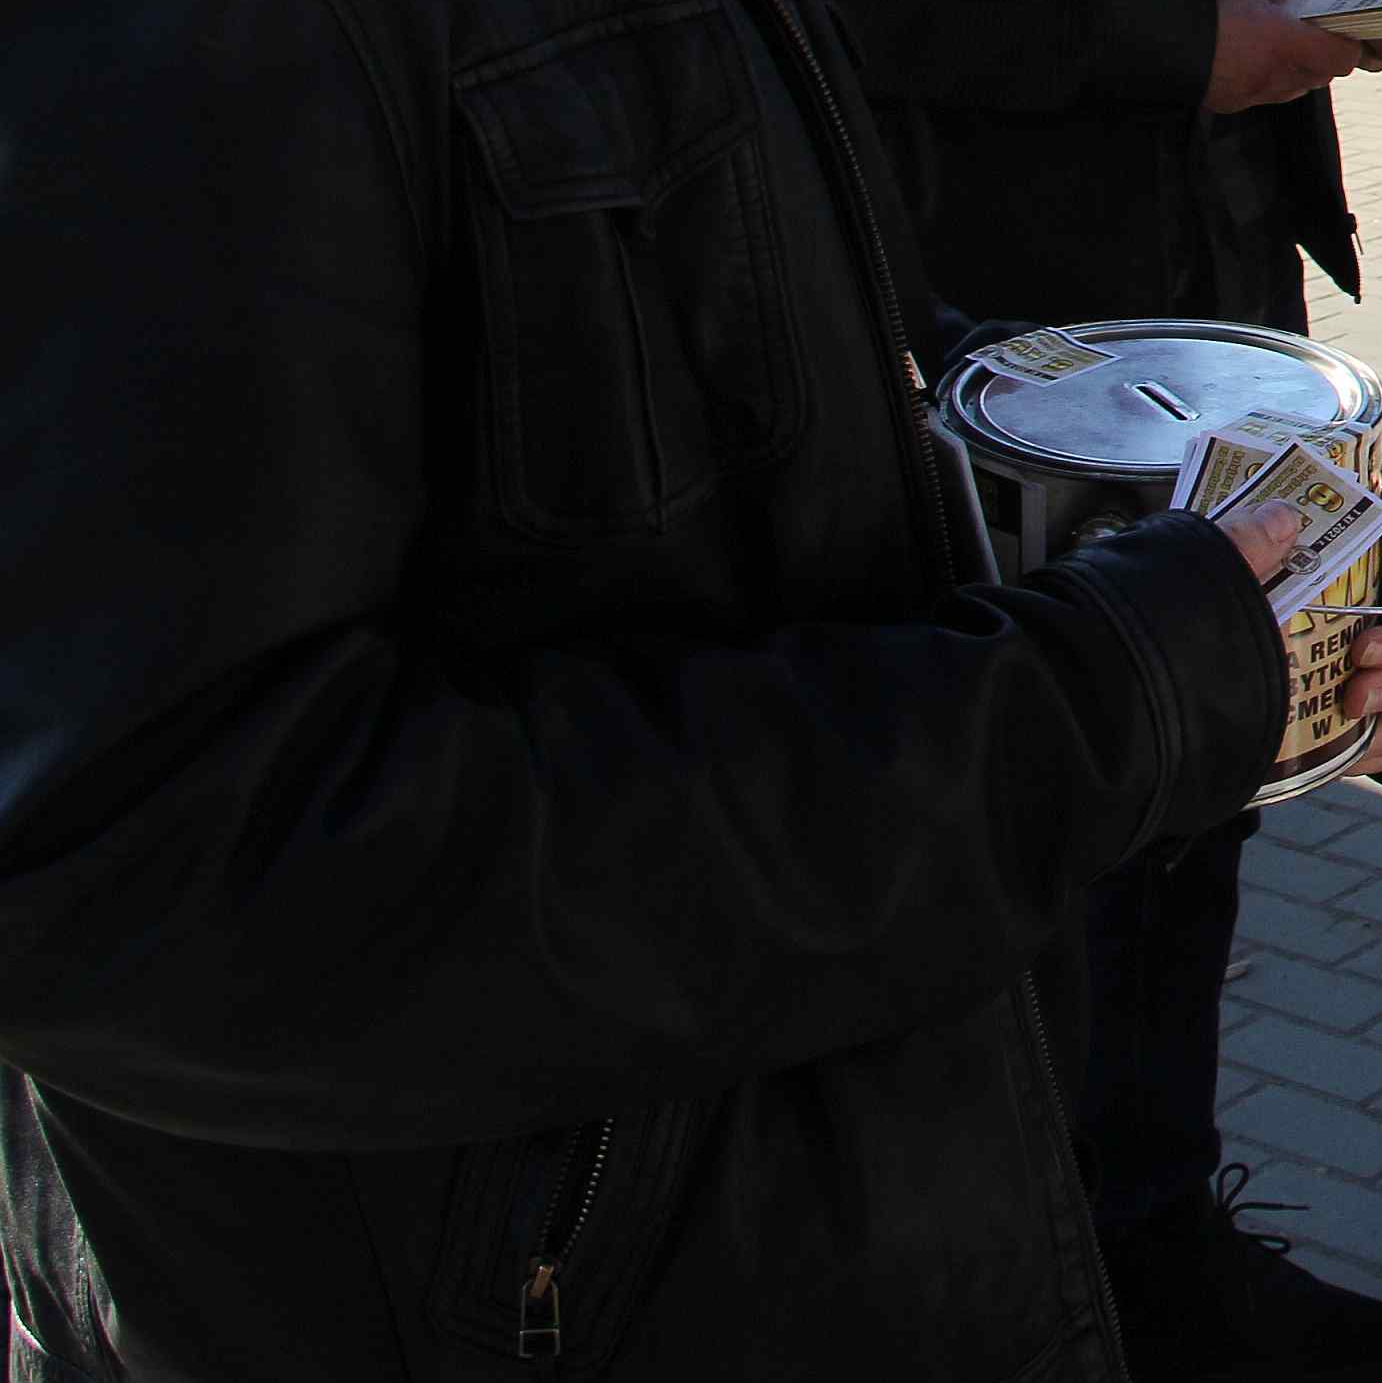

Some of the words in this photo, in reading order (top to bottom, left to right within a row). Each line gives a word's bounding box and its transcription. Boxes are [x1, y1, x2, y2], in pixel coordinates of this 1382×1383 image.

[1323, 521, 1346, 543] 2021
[1310, 619, 1367, 664] RENO
[1311, 714, 1333, 741] W
